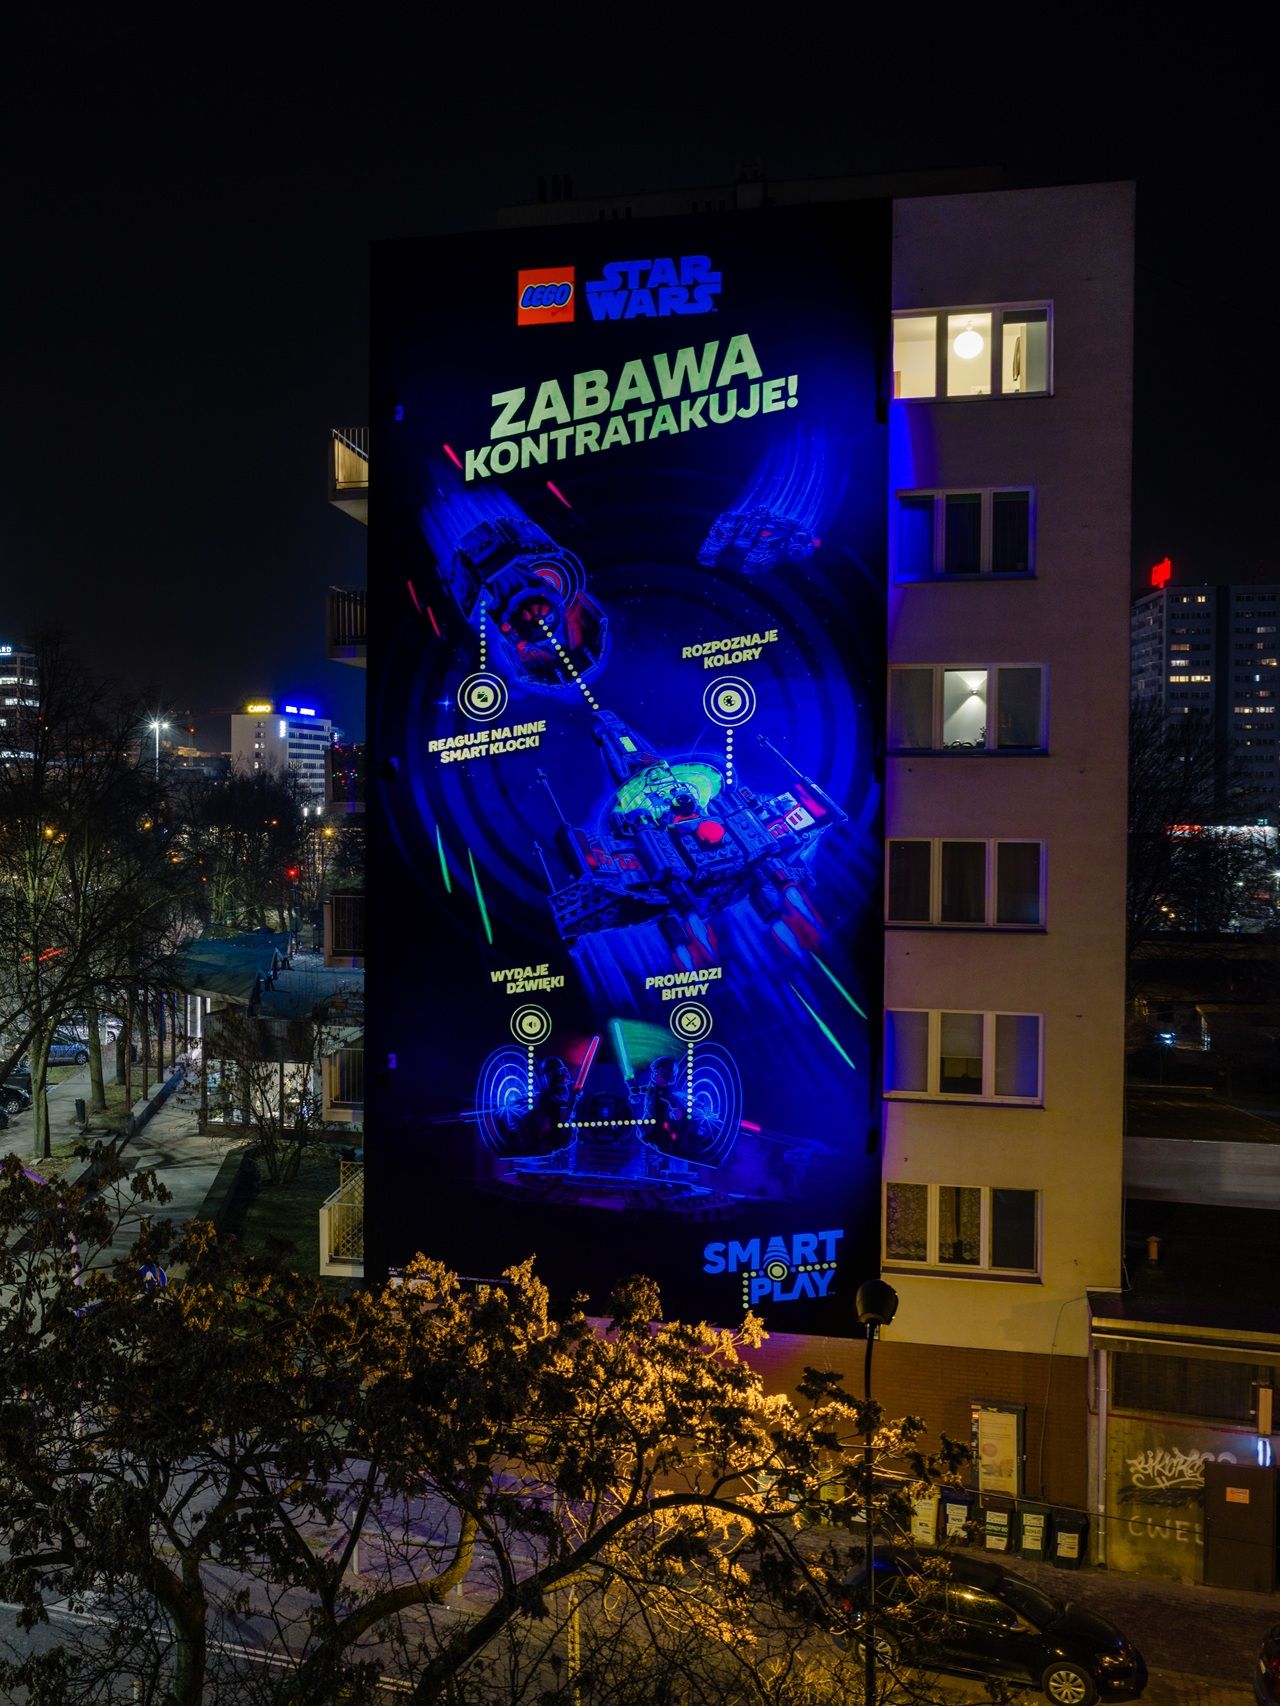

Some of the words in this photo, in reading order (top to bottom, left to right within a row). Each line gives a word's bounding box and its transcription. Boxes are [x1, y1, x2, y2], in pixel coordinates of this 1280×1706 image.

[586, 255, 722, 292] STAR
[521, 283, 573, 309] LEGO
[586, 283, 722, 321] WARS
[490, 333, 763, 441] ZABAWA
[465, 374, 799, 482] KONTRATAKUJE!
[682, 629, 779, 659] ROZPOZNAJE
[703, 646, 763, 669] KOLORY
[428, 730, 490, 753] REAGUJE
[491, 726, 512, 741] NA
[513, 719, 547, 737] INNE
[440, 744, 489, 764] SMART
[489, 735, 540, 755] KLOCKI
[490, 963, 549, 983] WYDAJE
[506, 975, 565, 995] DŹWIĘKI
[645, 967, 722, 990] PROWADZI
[662, 983, 709, 1001] BITWY
[703, 1229, 844, 1274] SMART
[751, 1269, 836, 1305] PLAY
